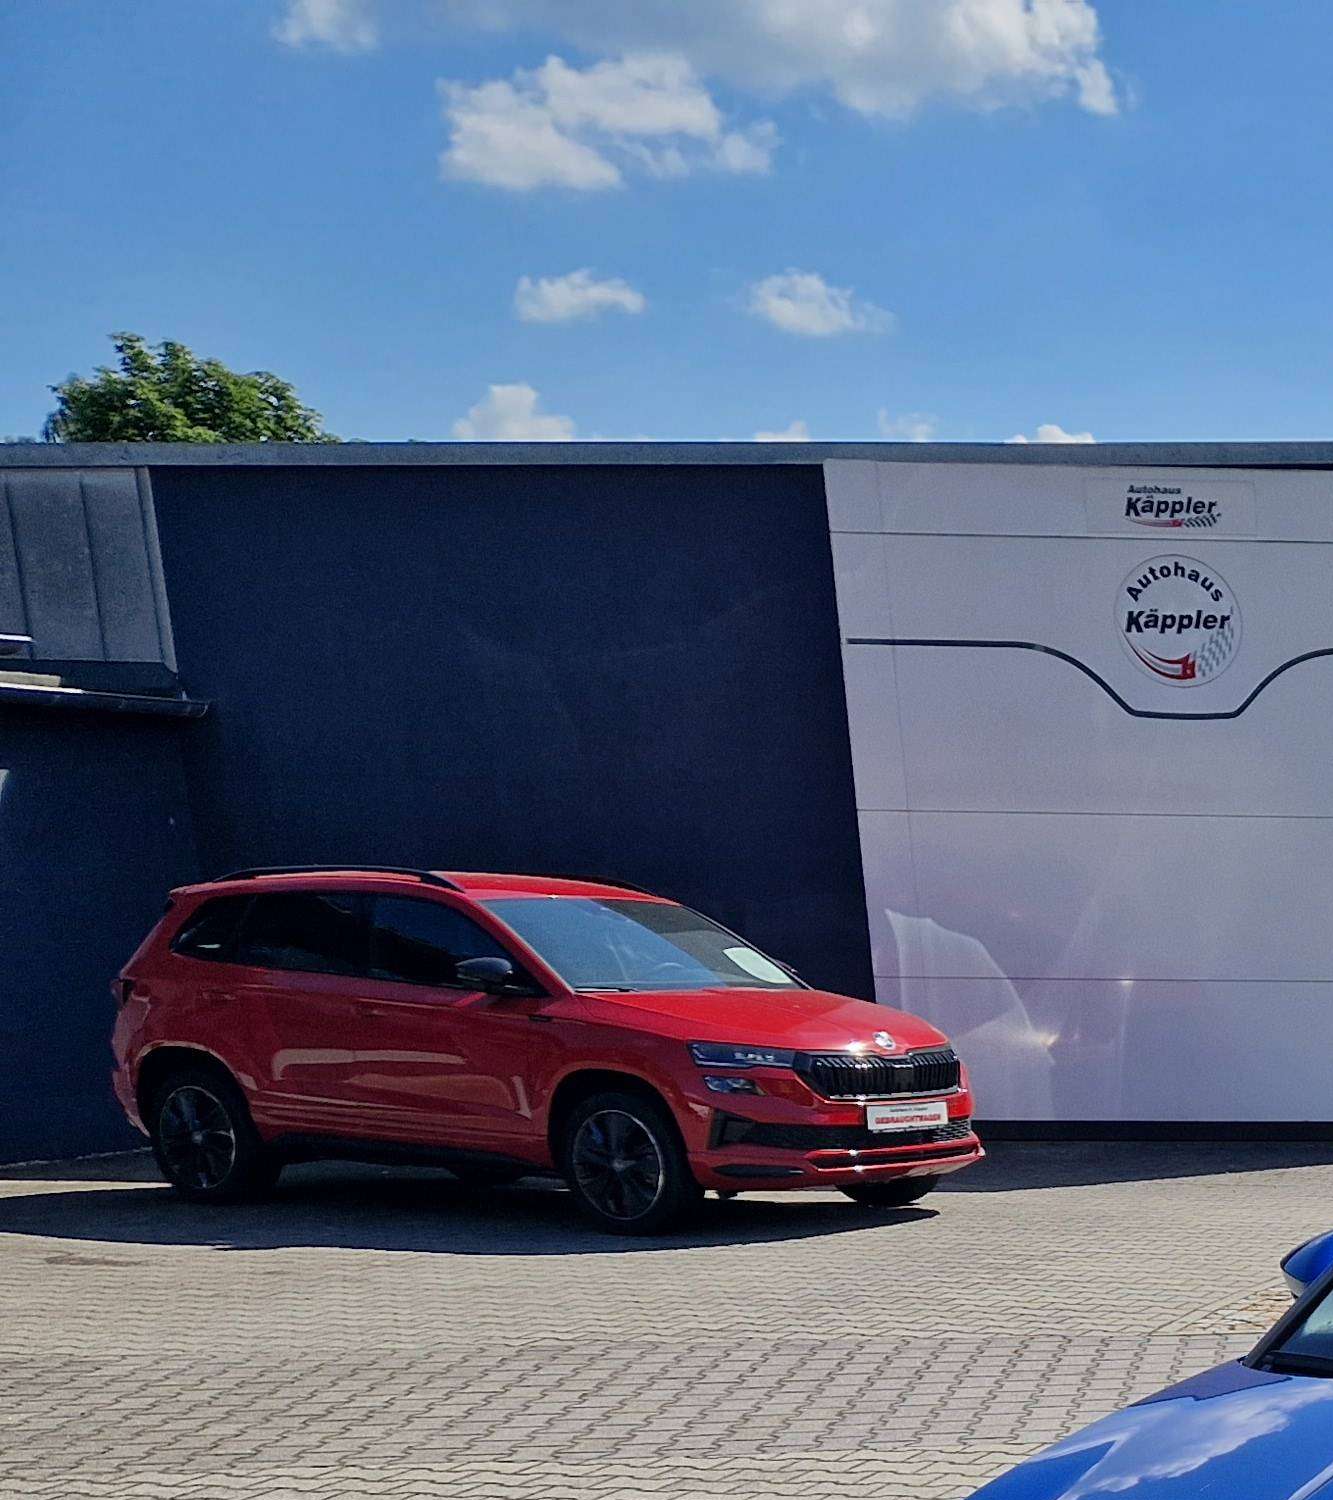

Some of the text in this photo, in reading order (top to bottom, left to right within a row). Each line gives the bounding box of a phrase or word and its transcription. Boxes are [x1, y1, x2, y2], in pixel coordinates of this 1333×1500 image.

[1126, 484, 1182, 495] Autohaus
[1125, 496, 1218, 518] Käppler
[1126, 561, 1223, 602] Autohaus
[1125, 608, 1231, 634] Käppler
